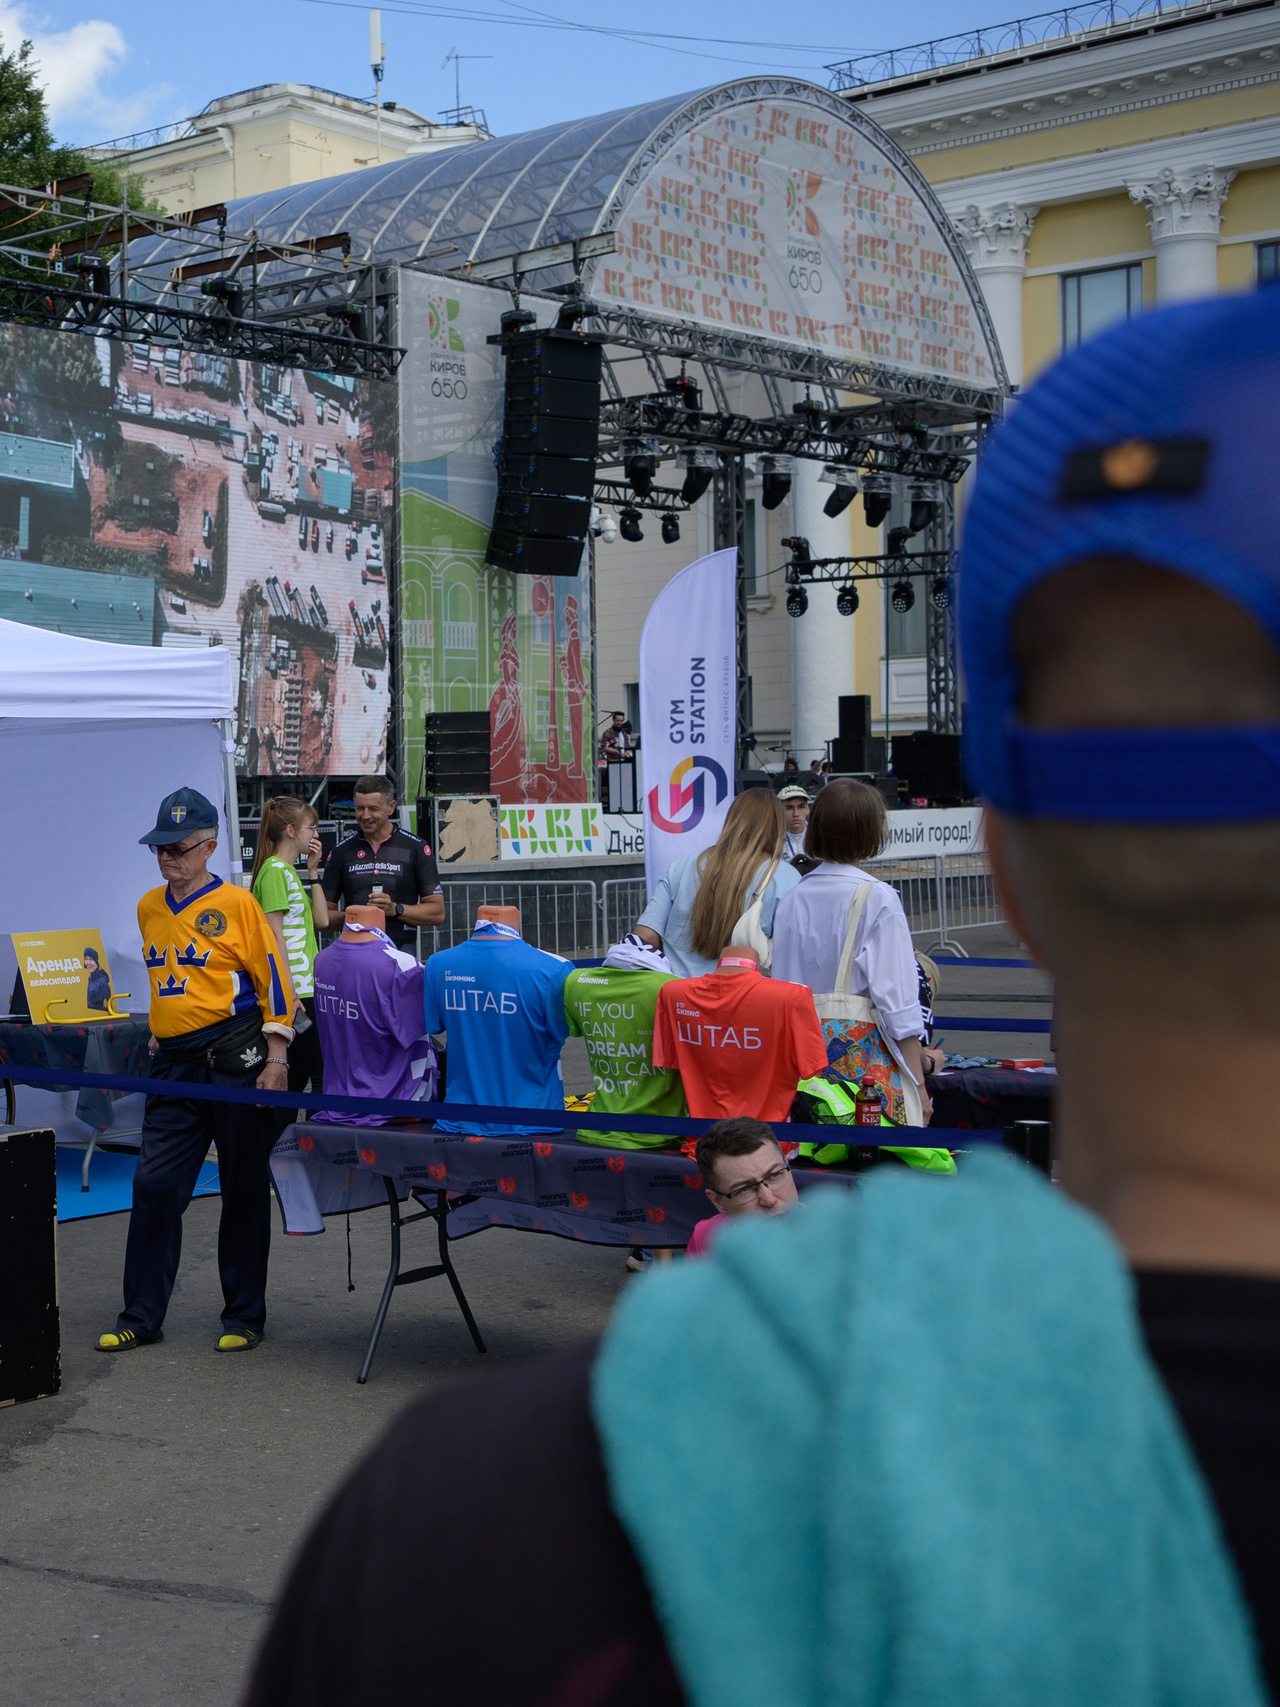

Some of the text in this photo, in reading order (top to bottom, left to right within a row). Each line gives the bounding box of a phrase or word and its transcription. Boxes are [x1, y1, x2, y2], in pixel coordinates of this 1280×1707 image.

[787, 245, 822, 265] КИРОВ
[789, 265, 823, 294] 650
[430, 360, 466, 376] КИРОВ
[431, 377, 467, 400] 650
[690, 657, 705, 744] STATION
[670, 699, 685, 744] GYM
[608, 829, 644, 855] Днё
[928, 820, 972, 847] город!
[242, 847, 254, 857] LED
[387, 863, 401, 872] Sport
[26, 956, 82, 977] Аренда
[29, 976, 81, 987] велосипедов
[577, 977, 609, 985] RUNNING
[317, 993, 359, 1020] ШТАБ
[445, 989, 518, 1014] ШТАБ
[596, 1002, 635, 1020] YOU
[676, 1008, 700, 1018] SKIING
[582, 1021, 616, 1038] CAN
[677, 1021, 762, 1050] ШТАБ
[587, 1041, 647, 1058] DREAM
[244, 1055, 263, 1069] adidas
[591, 1059, 666, 1077] YOU CAN
[593, 1075, 615, 1094] DO
